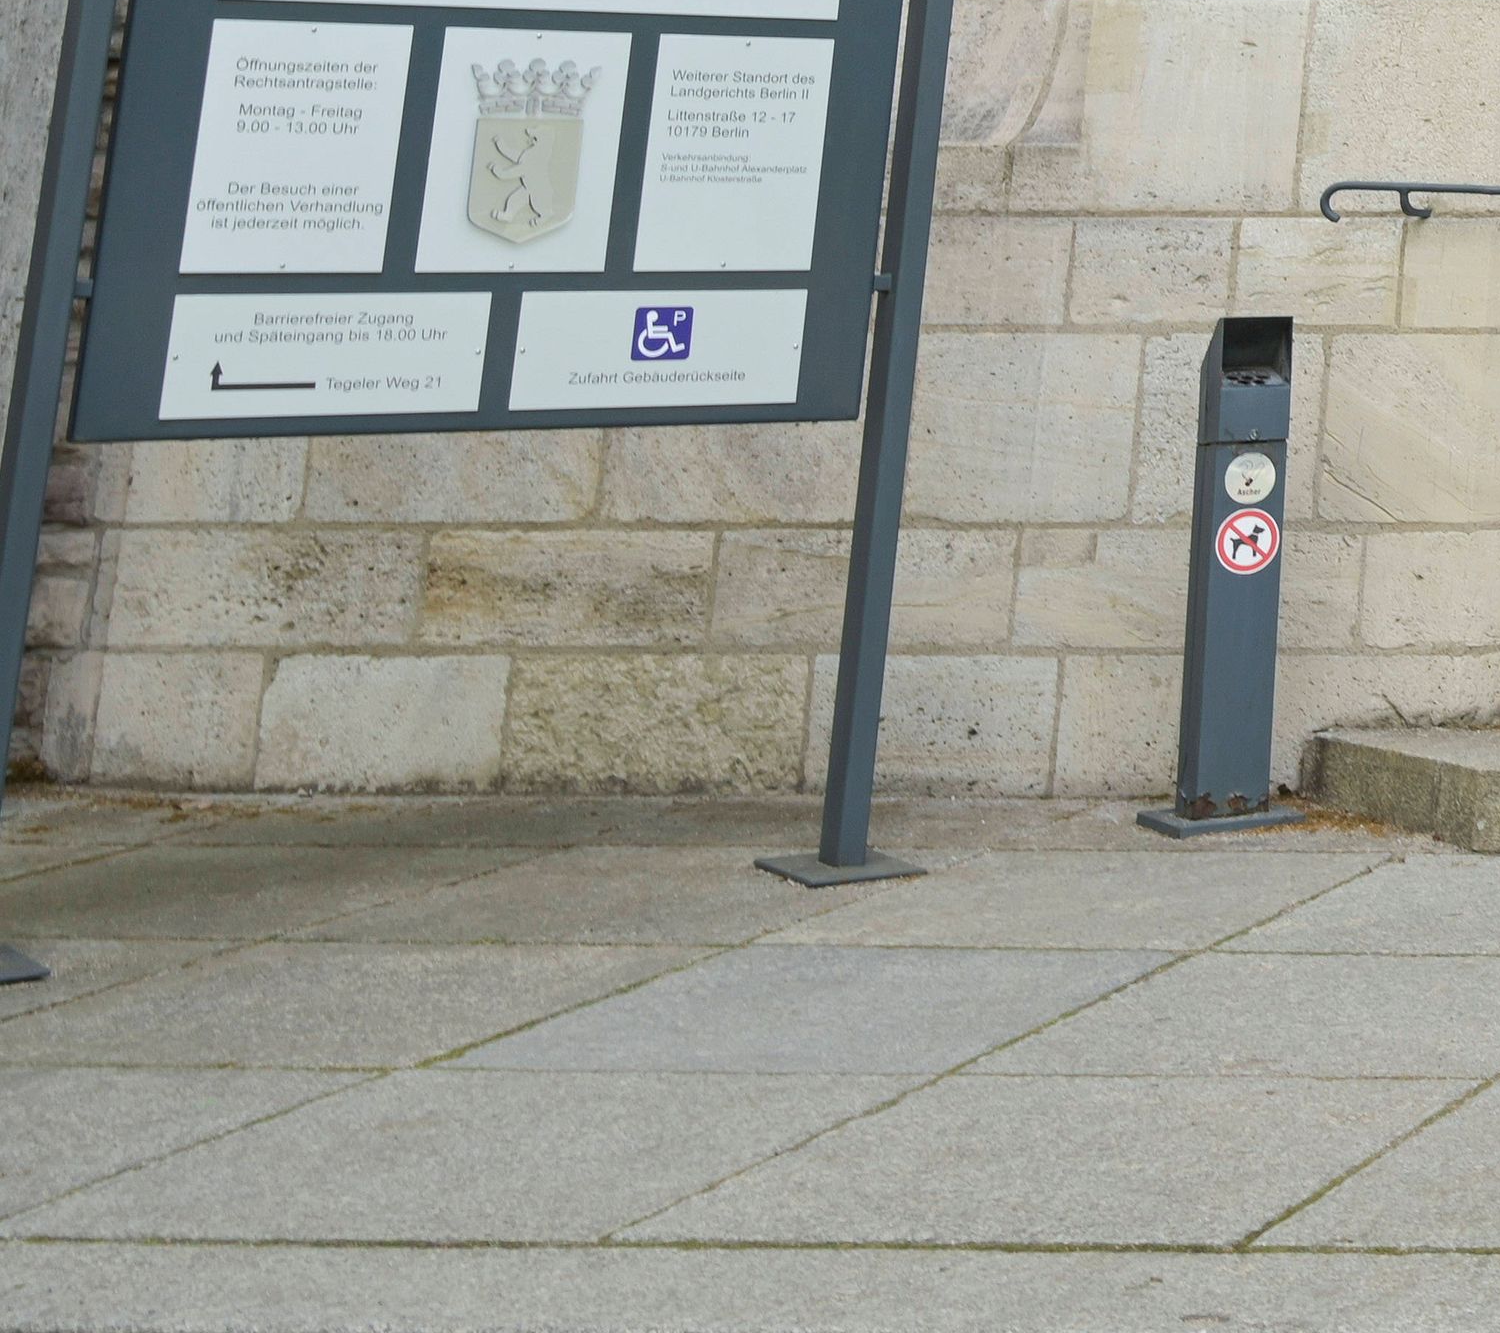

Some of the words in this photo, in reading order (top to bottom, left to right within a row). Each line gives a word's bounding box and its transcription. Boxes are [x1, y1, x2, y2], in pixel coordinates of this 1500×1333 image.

[236, 56, 349, 75] Öffnungszeiten
[353, 60, 379, 74] der
[234, 74, 378, 92] Rechtsantragstelle:
[672, 69, 729, 83] Weiterer
[733, 70, 788, 84] Standort
[792, 72, 815, 85] des
[670, 85, 756, 100] Landgerichts
[760, 87, 797, 100] Berlin
[801, 88, 810, 100] II
[239, 103, 296, 118] Montag
[311, 104, 363, 120] Freitag
[667, 109, 746, 123] Littenstraße
[752, 110, 767, 123] 12
[782, 111, 796, 124] 17
[236, 119, 270, 133] 9.00
[287, 120, 328, 134] 13.00
[332, 121, 359, 135] Uhr
[667, 125, 708, 137] 10179
[711, 126, 749, 138] Berlin
[662, 152, 752, 163] Verkehrsanbindung:
[691, 164, 739, 173] U-Bahnhof
[741, 165, 807, 174] Alexanderplatz
[659, 174, 705, 183] U-Bahnhof
[227, 182, 256, 196] Der
[260, 182, 317, 196] Besuch
[321, 183, 360, 196] einer
[196, 199, 284, 213] öffentlichen
[290, 199, 384, 215] Verhandlung
[211, 217, 228, 229] ist
[232, 217, 298, 233] jederzeit
[302, 218, 365, 233] möglich.
[254, 312, 353, 326] Barrierefreier
[357, 312, 415, 327] Zugang
[673, 310, 688, 327] P
[214, 330, 243, 343] und
[248, 329, 344, 345] Späteingang
[348, 330, 370, 342] bis
[376, 329, 417, 342] 18.00
[421, 329, 448, 341] Uhr
[326, 376, 382, 392] Tegeler
[386, 376, 420, 392] Weg
[425, 376, 443, 388] 21
[568, 371, 619, 385] Zufahrt
[622, 369, 746, 384] Gebäuderückseite
